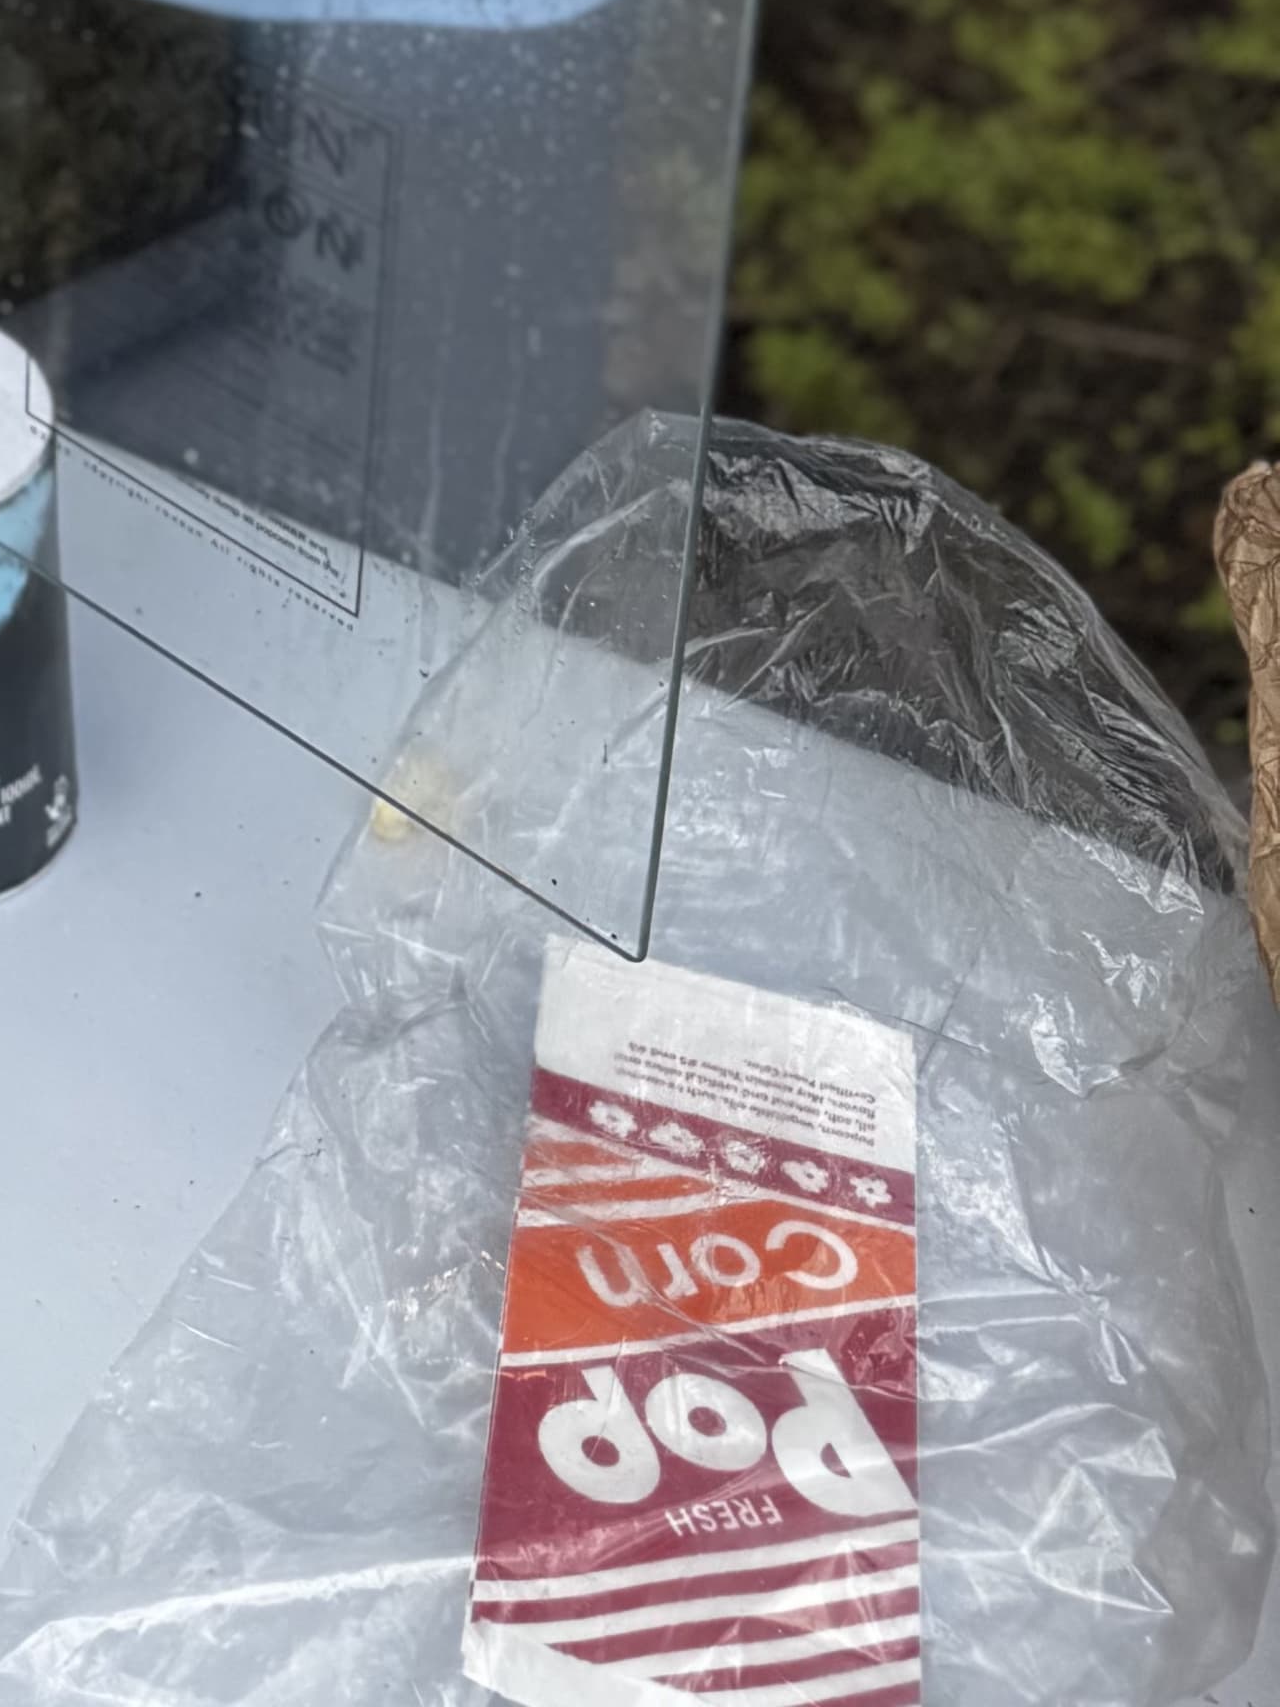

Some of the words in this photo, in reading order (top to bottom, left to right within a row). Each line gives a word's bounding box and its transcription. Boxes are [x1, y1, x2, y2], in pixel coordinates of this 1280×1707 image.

[288, 587, 354, 632] reserved
[575, 1220, 858, 1308] Corn
[663, 1494, 784, 1537] FRESH
